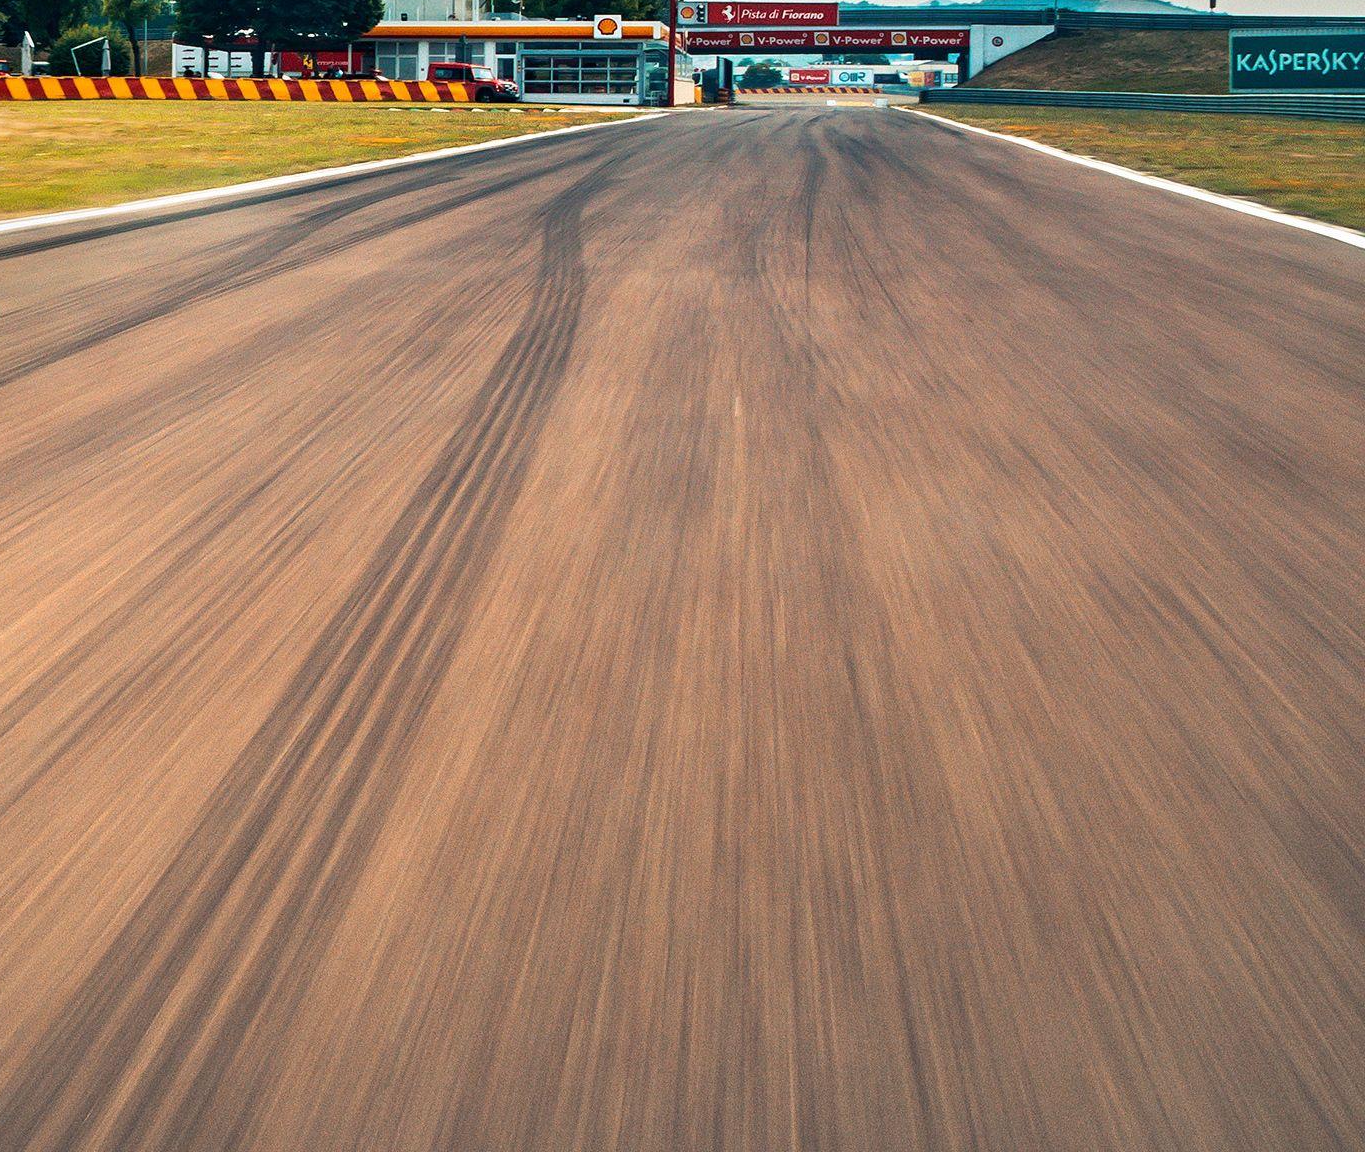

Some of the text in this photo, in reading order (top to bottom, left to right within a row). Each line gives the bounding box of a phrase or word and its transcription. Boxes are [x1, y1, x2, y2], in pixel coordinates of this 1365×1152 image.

[741, 9, 824, 20] Pista di Fiorano
[757, 36, 806, 45] V-Power
[833, 35, 883, 45] V-Power
[910, 35, 962, 45] V-Power
[1236, 48, 1364, 75] KASPERSKY
